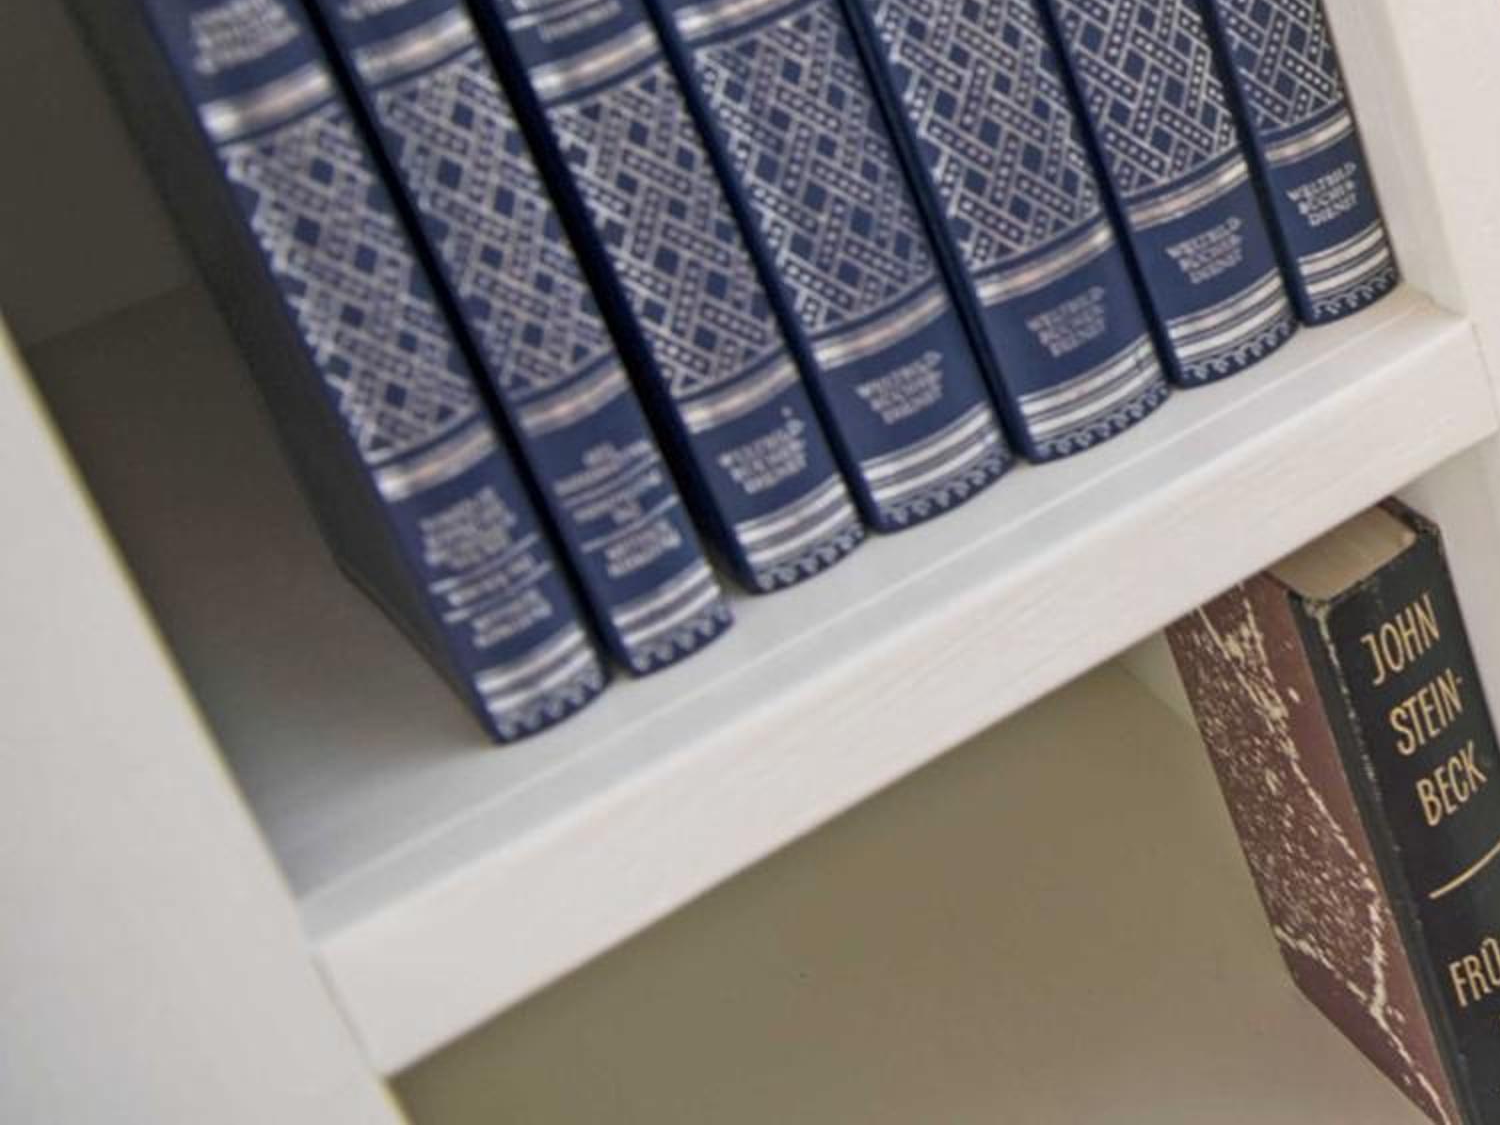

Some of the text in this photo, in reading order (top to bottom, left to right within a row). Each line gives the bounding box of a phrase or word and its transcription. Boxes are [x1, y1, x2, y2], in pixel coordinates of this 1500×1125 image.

[1360, 592, 1440, 686] JOHN
[1390, 668, 1463, 756] STEIN-
[1415, 739, 1487, 827] BECK
